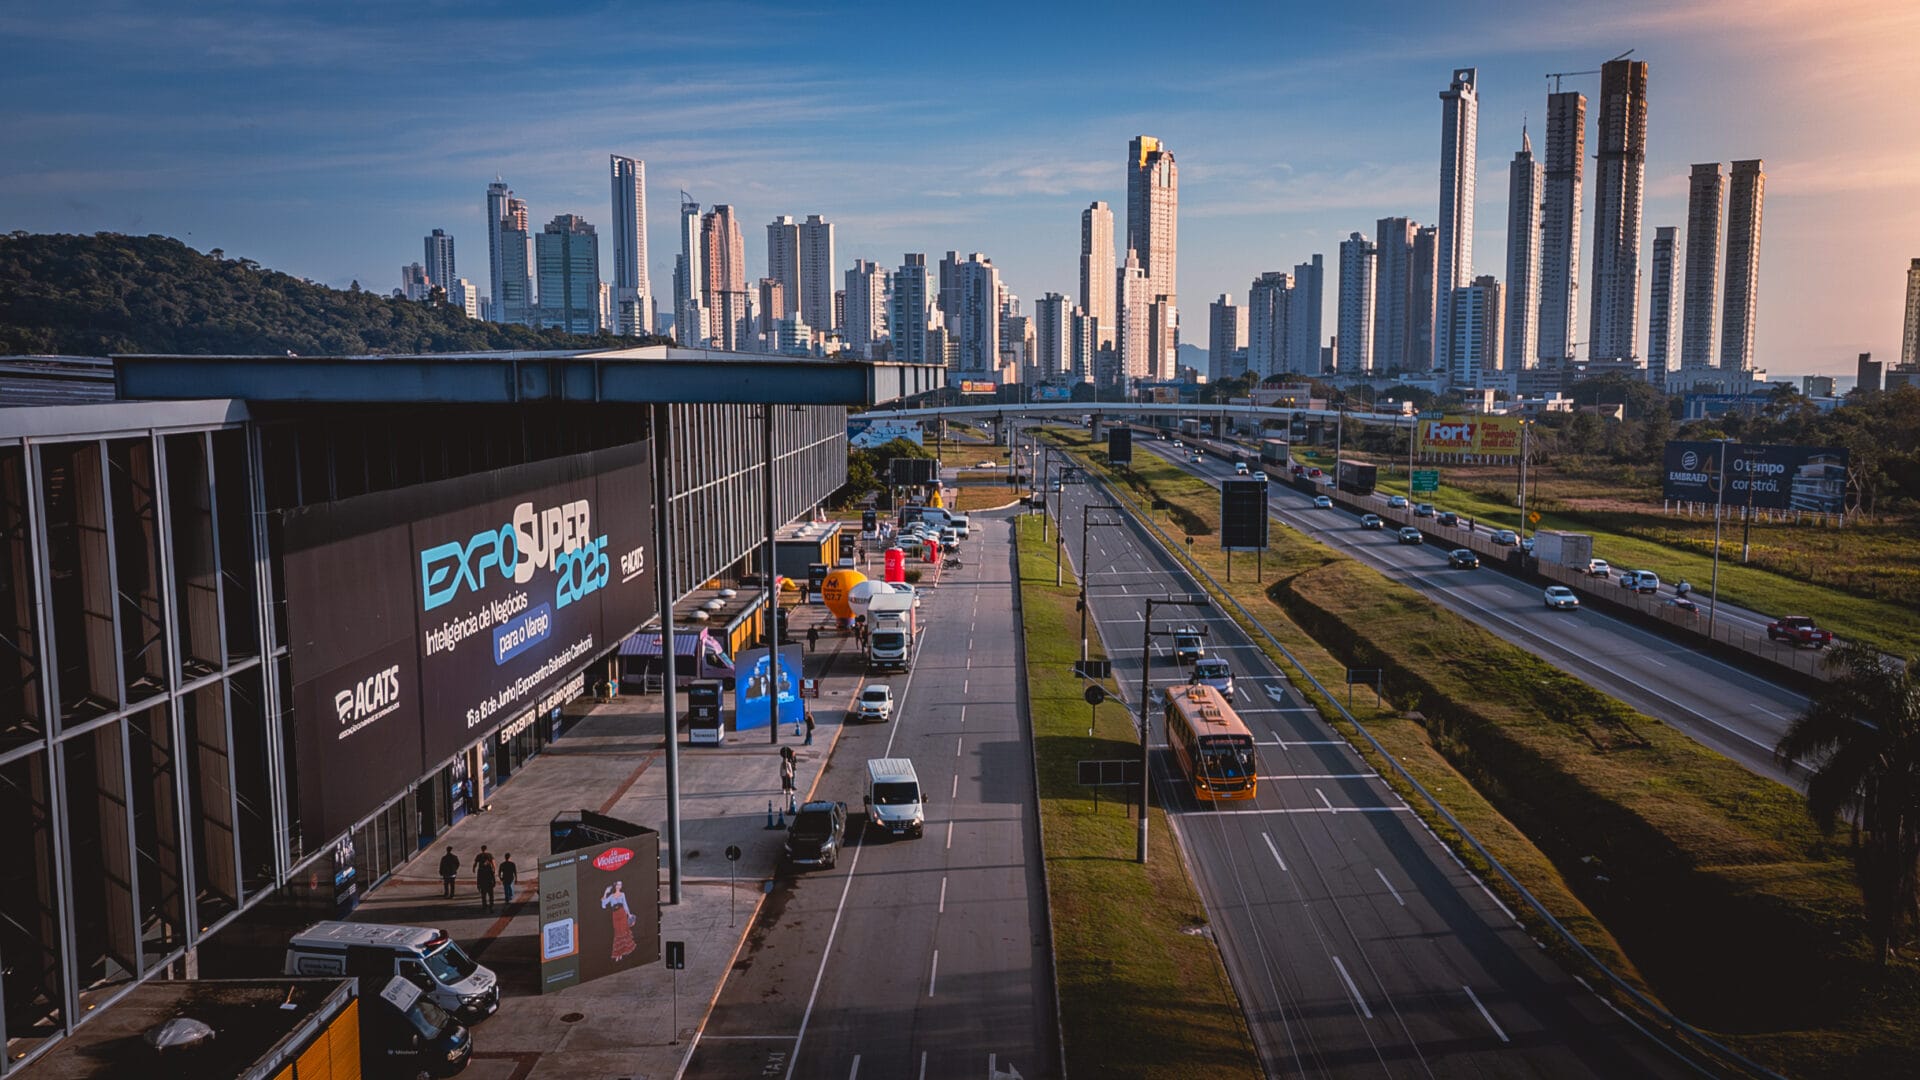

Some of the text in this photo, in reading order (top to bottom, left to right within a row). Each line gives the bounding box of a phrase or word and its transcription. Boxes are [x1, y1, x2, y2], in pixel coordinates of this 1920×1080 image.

[1430, 421, 1471, 441] Fort
[1669, 471, 1709, 483] EMBRAED
[1733, 459, 1785, 476] O tempo
[555, 533, 610, 611] 2025
[627, 545, 645, 575] ACATS
[425, 590, 528, 657] Inteligência de Negócios
[499, 610, 549, 660] para o Varejo
[354, 664, 399, 720] ACATS
[487, 695, 498, 717] de
[496, 683, 516, 711] Junho
[518, 663, 549, 698] Expocentro
[501, 708, 536, 744] EXPOCENTRO
[538, 689, 564, 718] BALNEÁRIO
[597, 852, 630, 868] Violetera
[546, 889, 569, 902] SIGA
[762, 1052, 786, 1077] TAXI
